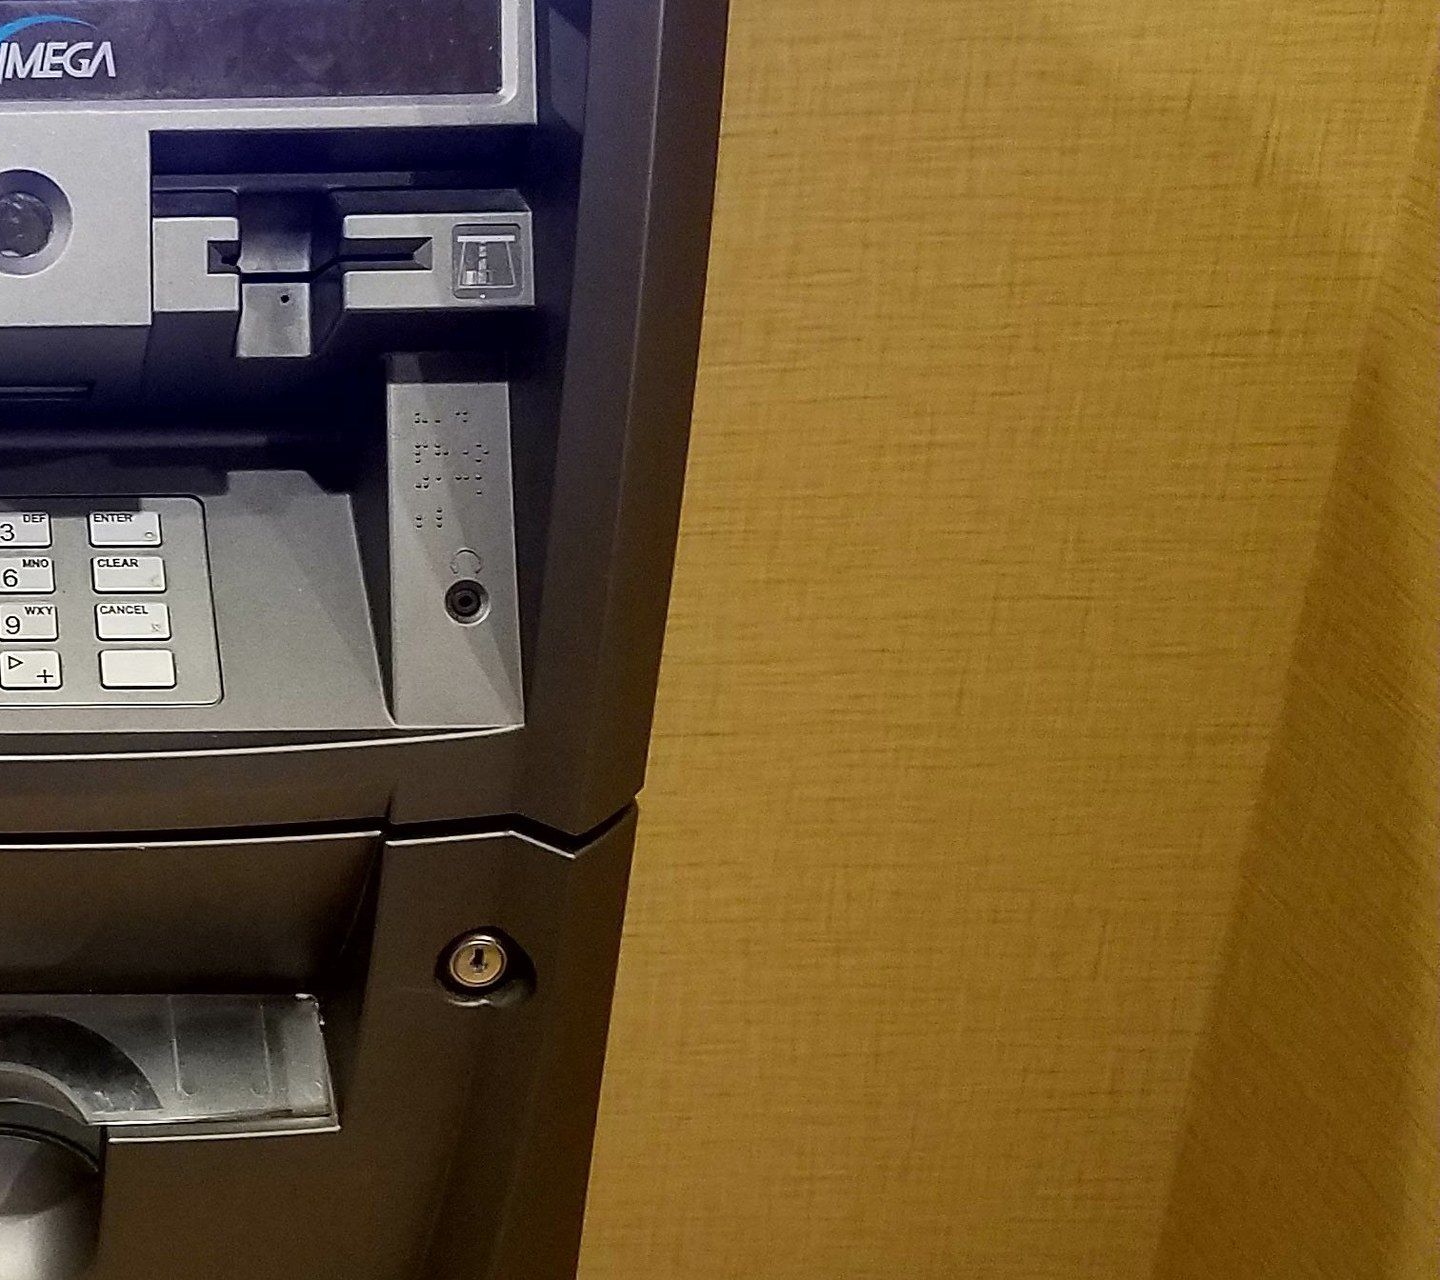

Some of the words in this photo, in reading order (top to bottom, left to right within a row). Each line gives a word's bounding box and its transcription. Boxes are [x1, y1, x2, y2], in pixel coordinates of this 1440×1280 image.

[23, 514, 47, 523] DEF
[93, 513, 134, 523] ENTER
[0, 523, 15, 542] 3
[22, 559, 49, 568] MNO
[97, 558, 139, 568] CLEAR
[3, 569, 18, 588] 6
[24, 606, 53, 616] WXY
[100, 605, 149, 615] CANCEL
[5, 616, 20, 635] 9
